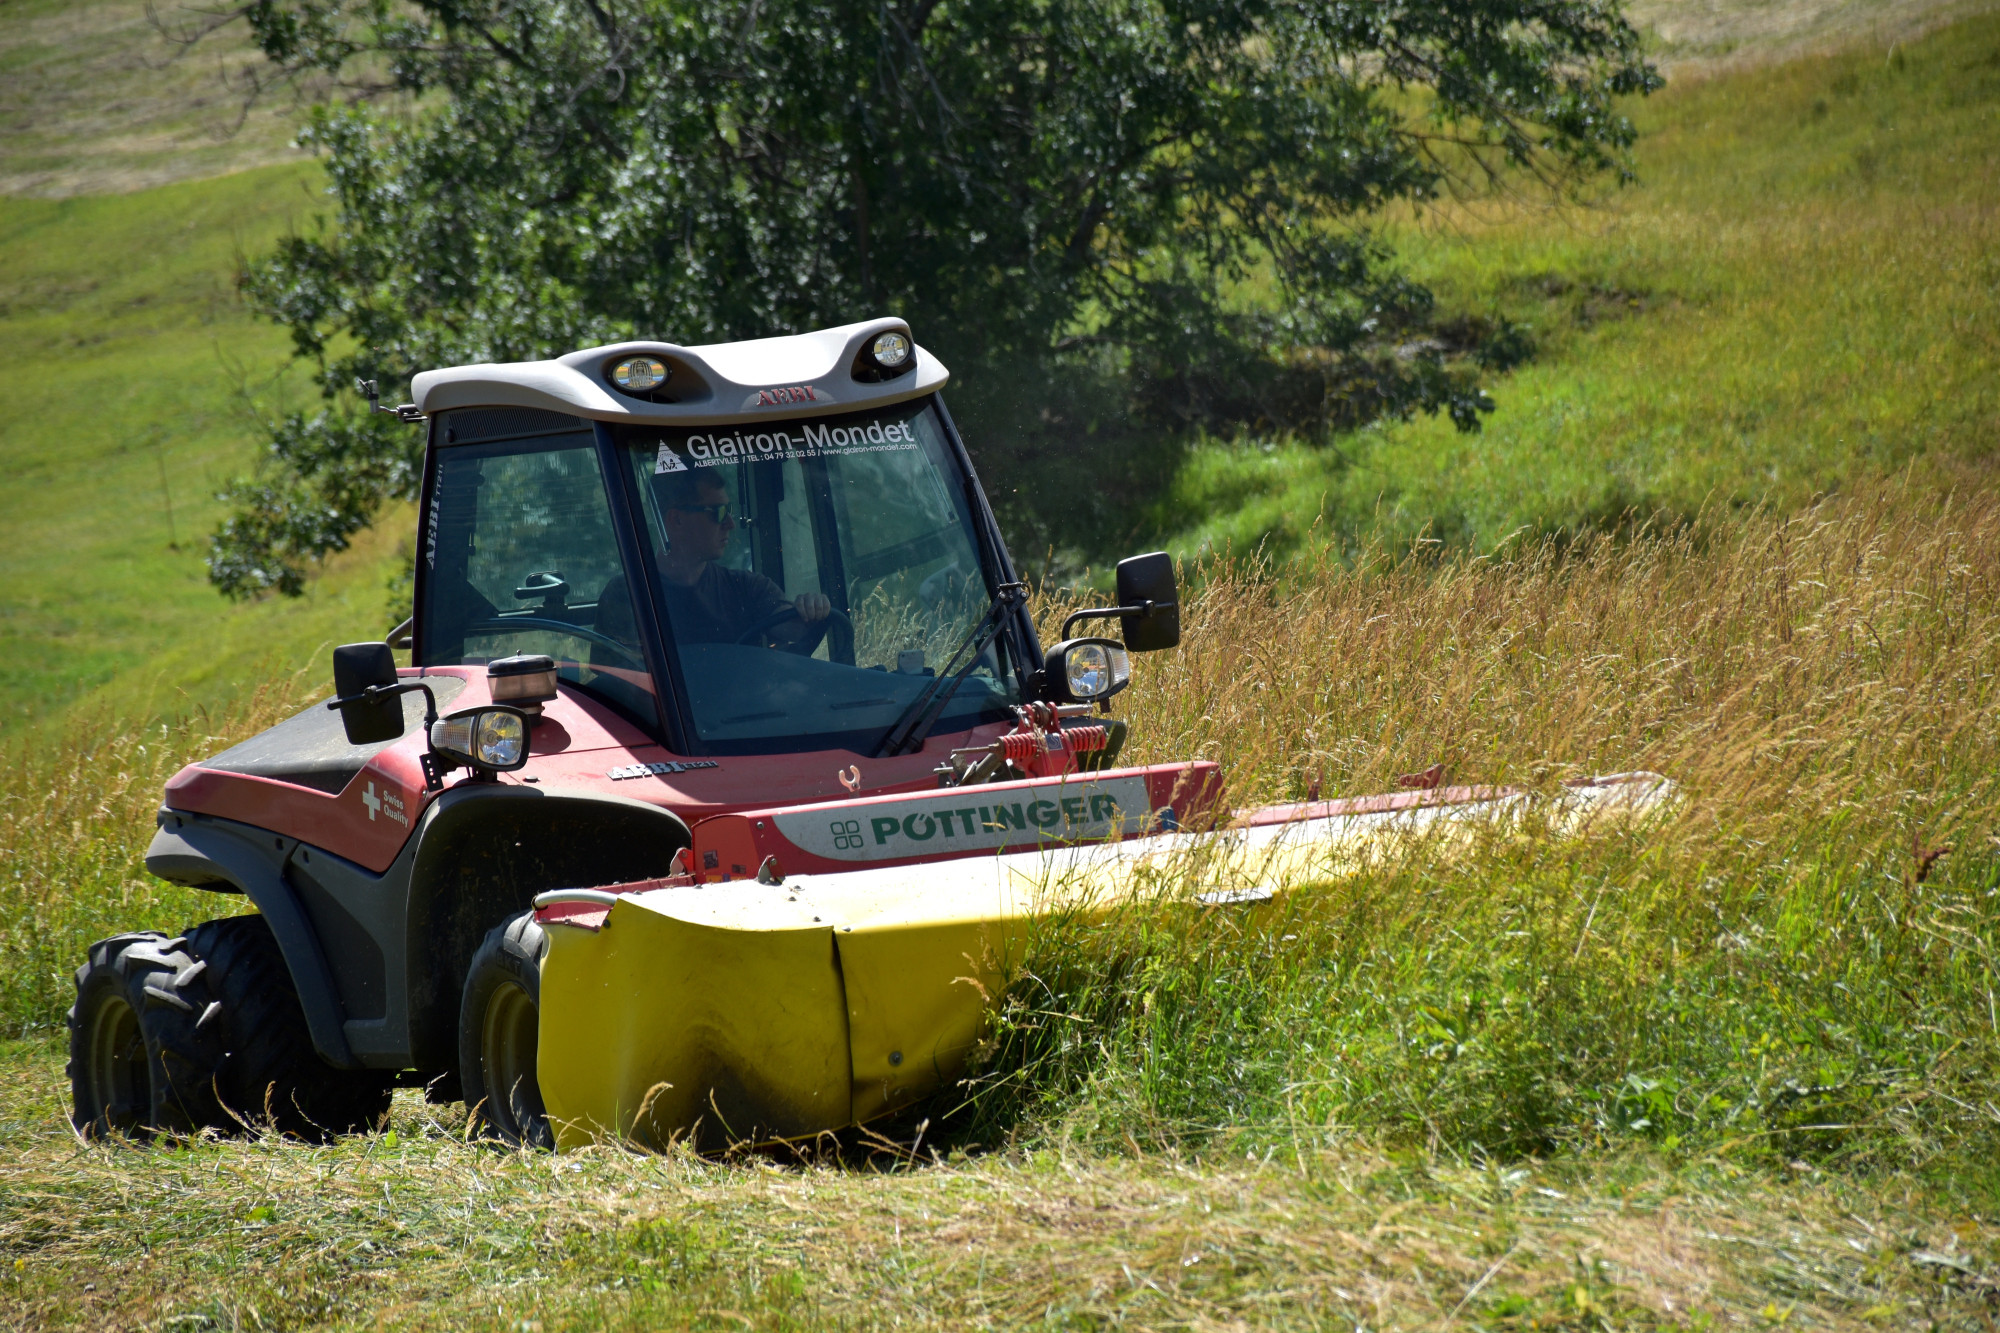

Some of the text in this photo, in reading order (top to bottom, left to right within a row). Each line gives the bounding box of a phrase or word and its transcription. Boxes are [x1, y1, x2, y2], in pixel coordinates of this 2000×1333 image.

[757, 385, 817, 406] AEBI
[686, 420, 914, 460] Glairon-Mondet
[694, 456, 739, 468] ALBERTVILLE
[747, 454, 760, 462] TEL
[764, 453, 775, 461] 04
[775, 452, 784, 460] 79
[785, 451, 796, 459] 32
[796, 450, 806, 458] 02
[807, 449, 816, 457] 55
[821, 443, 918, 456] www.glairon-mondet.com
[426, 498, 440, 570] AEBI
[606, 763, 686, 781] AEBI
[383, 790, 404, 810] Swiss
[383, 804, 409, 828] Quality
[871, 794, 1118, 846] PÖTTINGER
